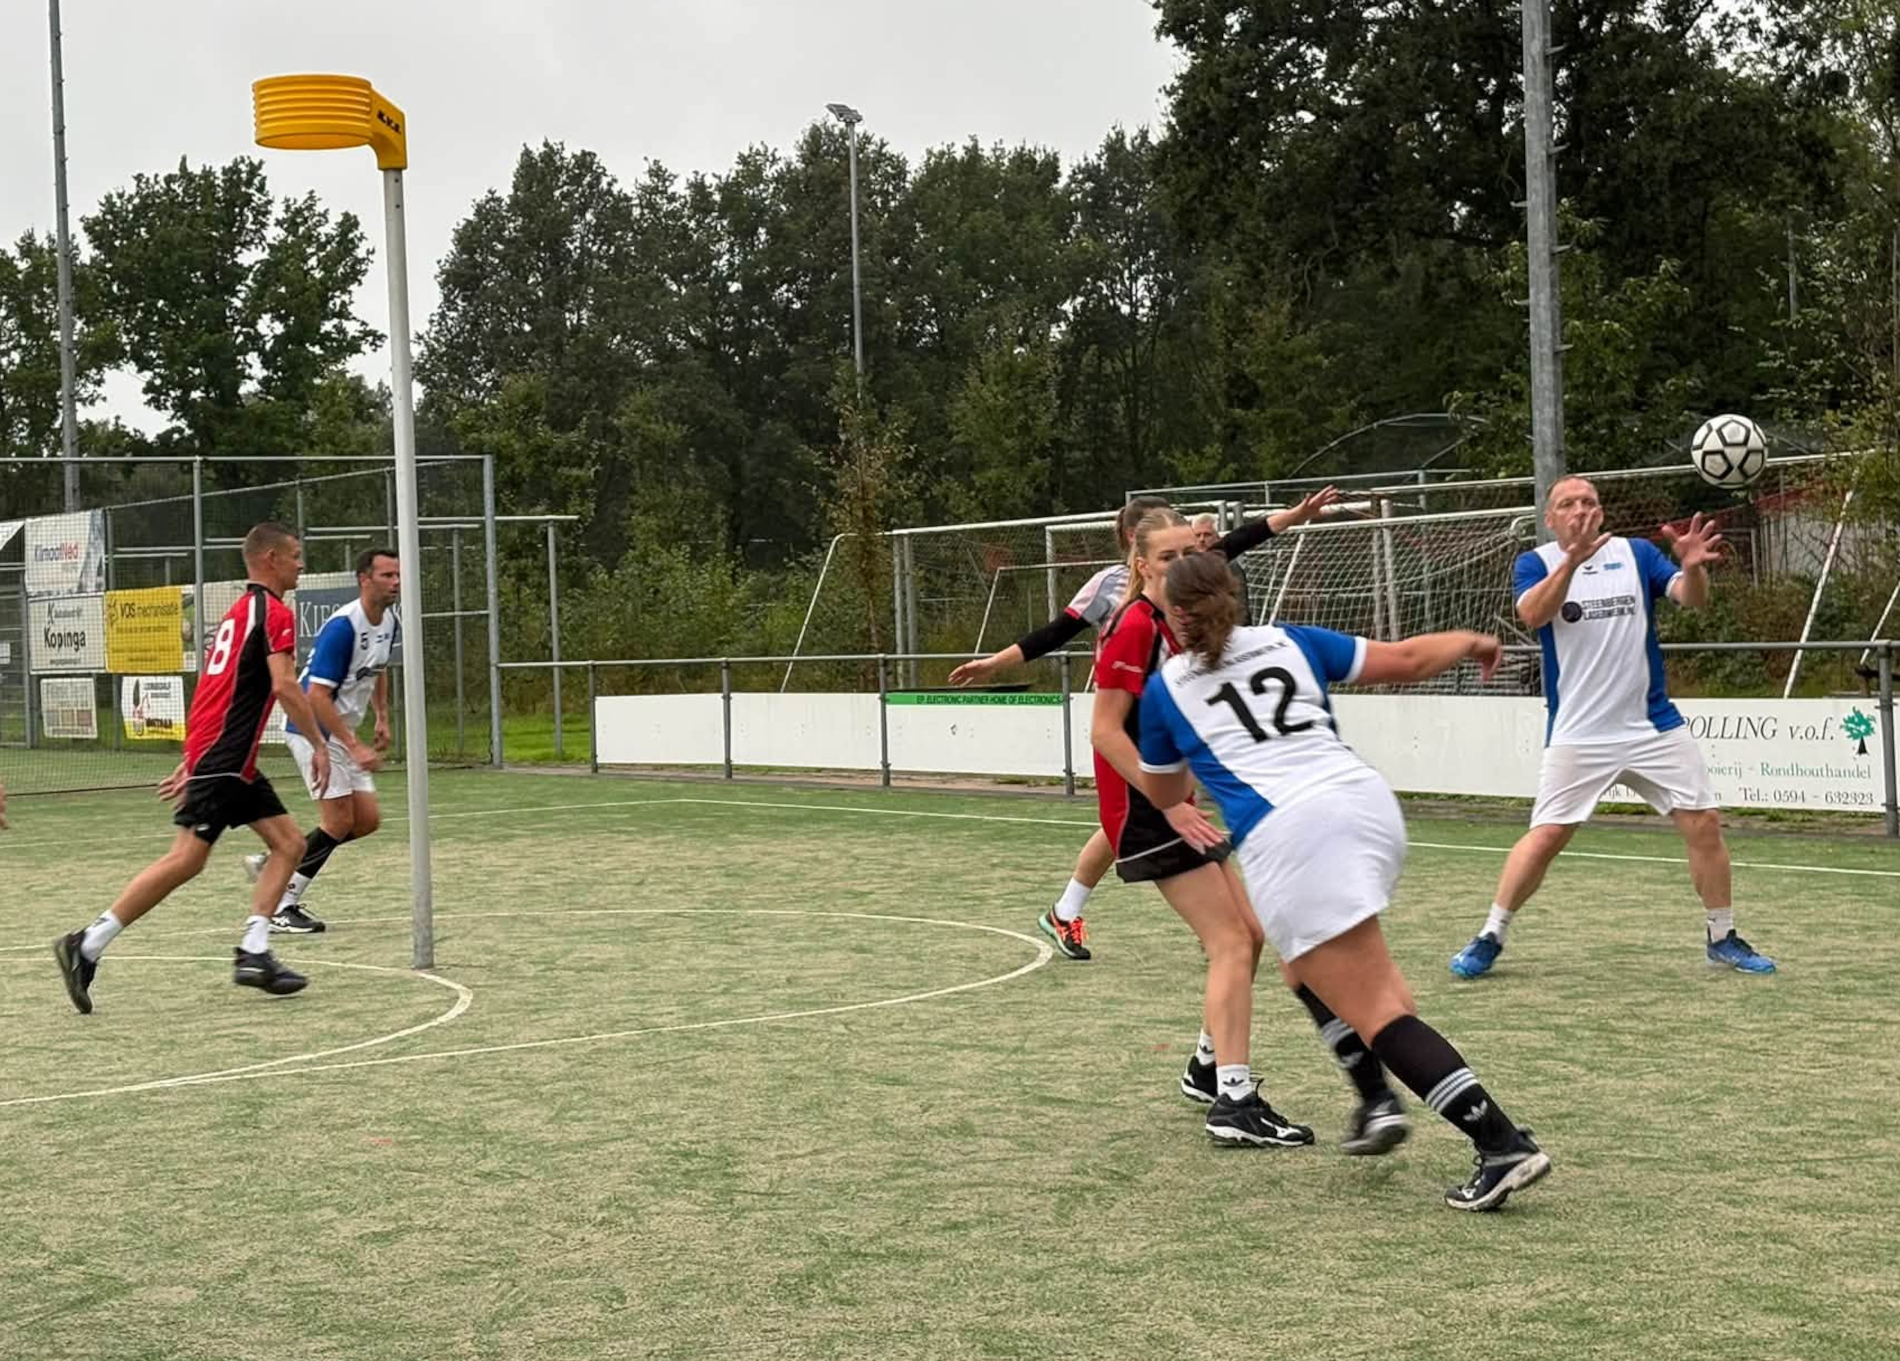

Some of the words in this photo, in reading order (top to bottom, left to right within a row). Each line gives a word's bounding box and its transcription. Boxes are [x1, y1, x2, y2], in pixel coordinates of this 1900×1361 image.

[121, 602, 135, 618] VOS
[44, 627, 86, 652] Kopinga
[207, 619, 235, 675] 8
[360, 632, 368, 650] 5
[926, 694, 962, 704] ELECTRONIC
[962, 694, 988, 704] PARTNER
[989, 694, 1007, 704] HOME
[1008, 694, 1018, 704] OF
[1018, 694, 1062, 704] ELECTRONICS
[1205, 666, 1315, 743] 12
[1761, 761, 1871, 780] Rondhouthandel
[1739, 786, 1769, 802] Tel.:
[1773, 789, 1806, 804] 0594
[1825, 791, 1874, 806] 632323
